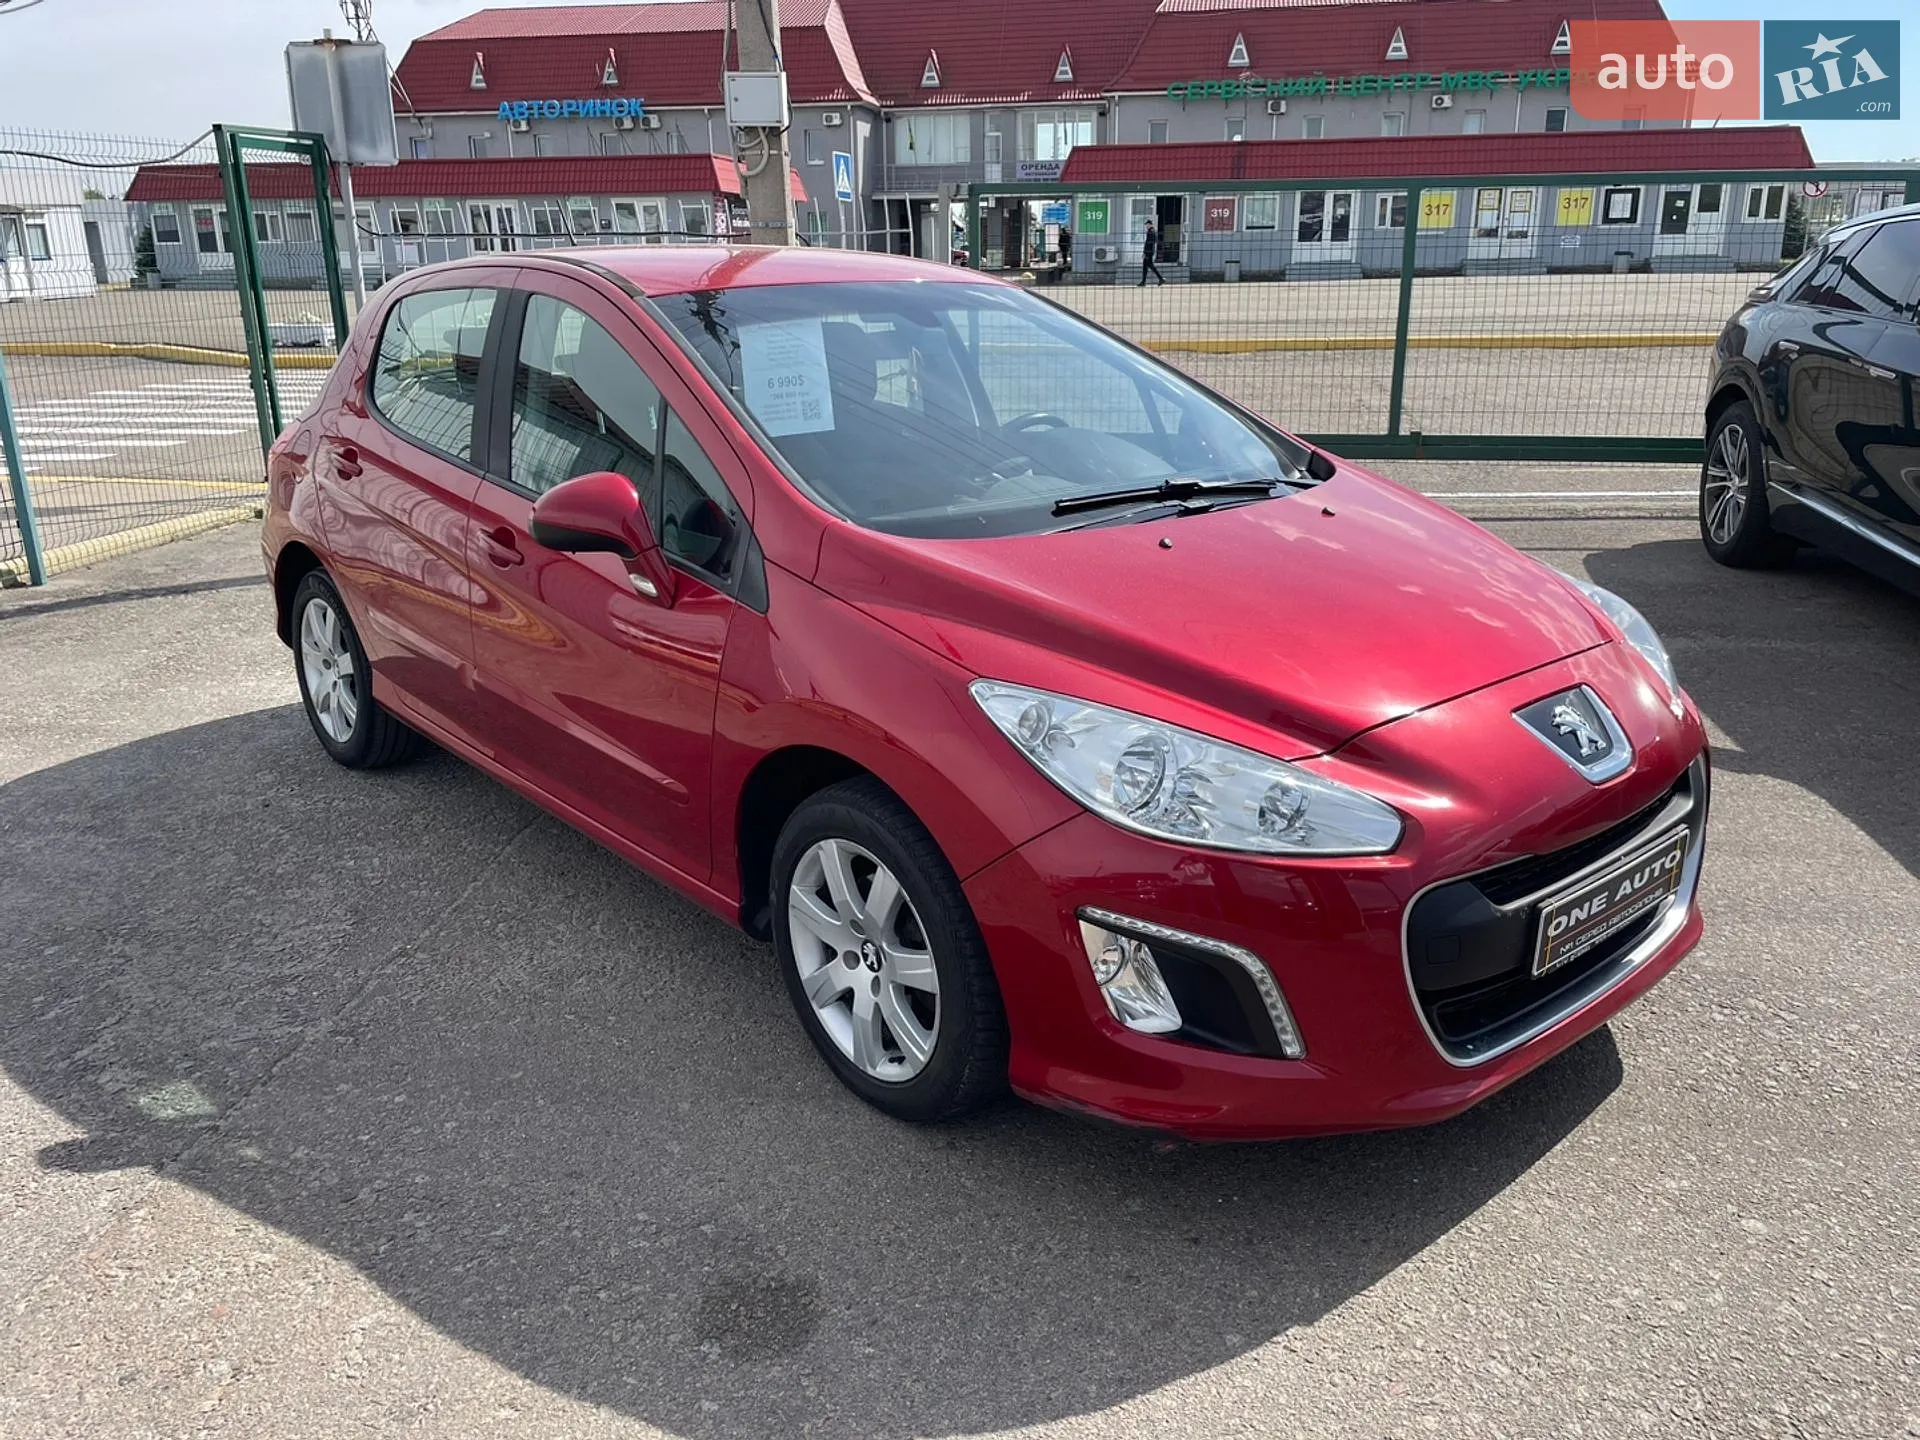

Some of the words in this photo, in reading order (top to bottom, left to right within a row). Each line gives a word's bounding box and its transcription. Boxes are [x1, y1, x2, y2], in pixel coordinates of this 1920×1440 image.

[1167, 72, 1327, 99] СЕРВІСНИЙ
[1338, 72, 1432, 97] ЦЕНТР
[1440, 70, 1506, 92] МВС
[1515, 66, 1634, 93] УКРА
[497, 97, 645, 121] АВТОРИНОК
[1021, 163, 1060, 171] ОРЕНДА
[1563, 197, 1589, 209] 317
[1084, 210, 1103, 220] 319
[1210, 208, 1231, 218] 319
[1424, 203, 1449, 216] 317
[1547, 891, 1609, 937] ONE
[1614, 850, 1681, 902] AUTO
